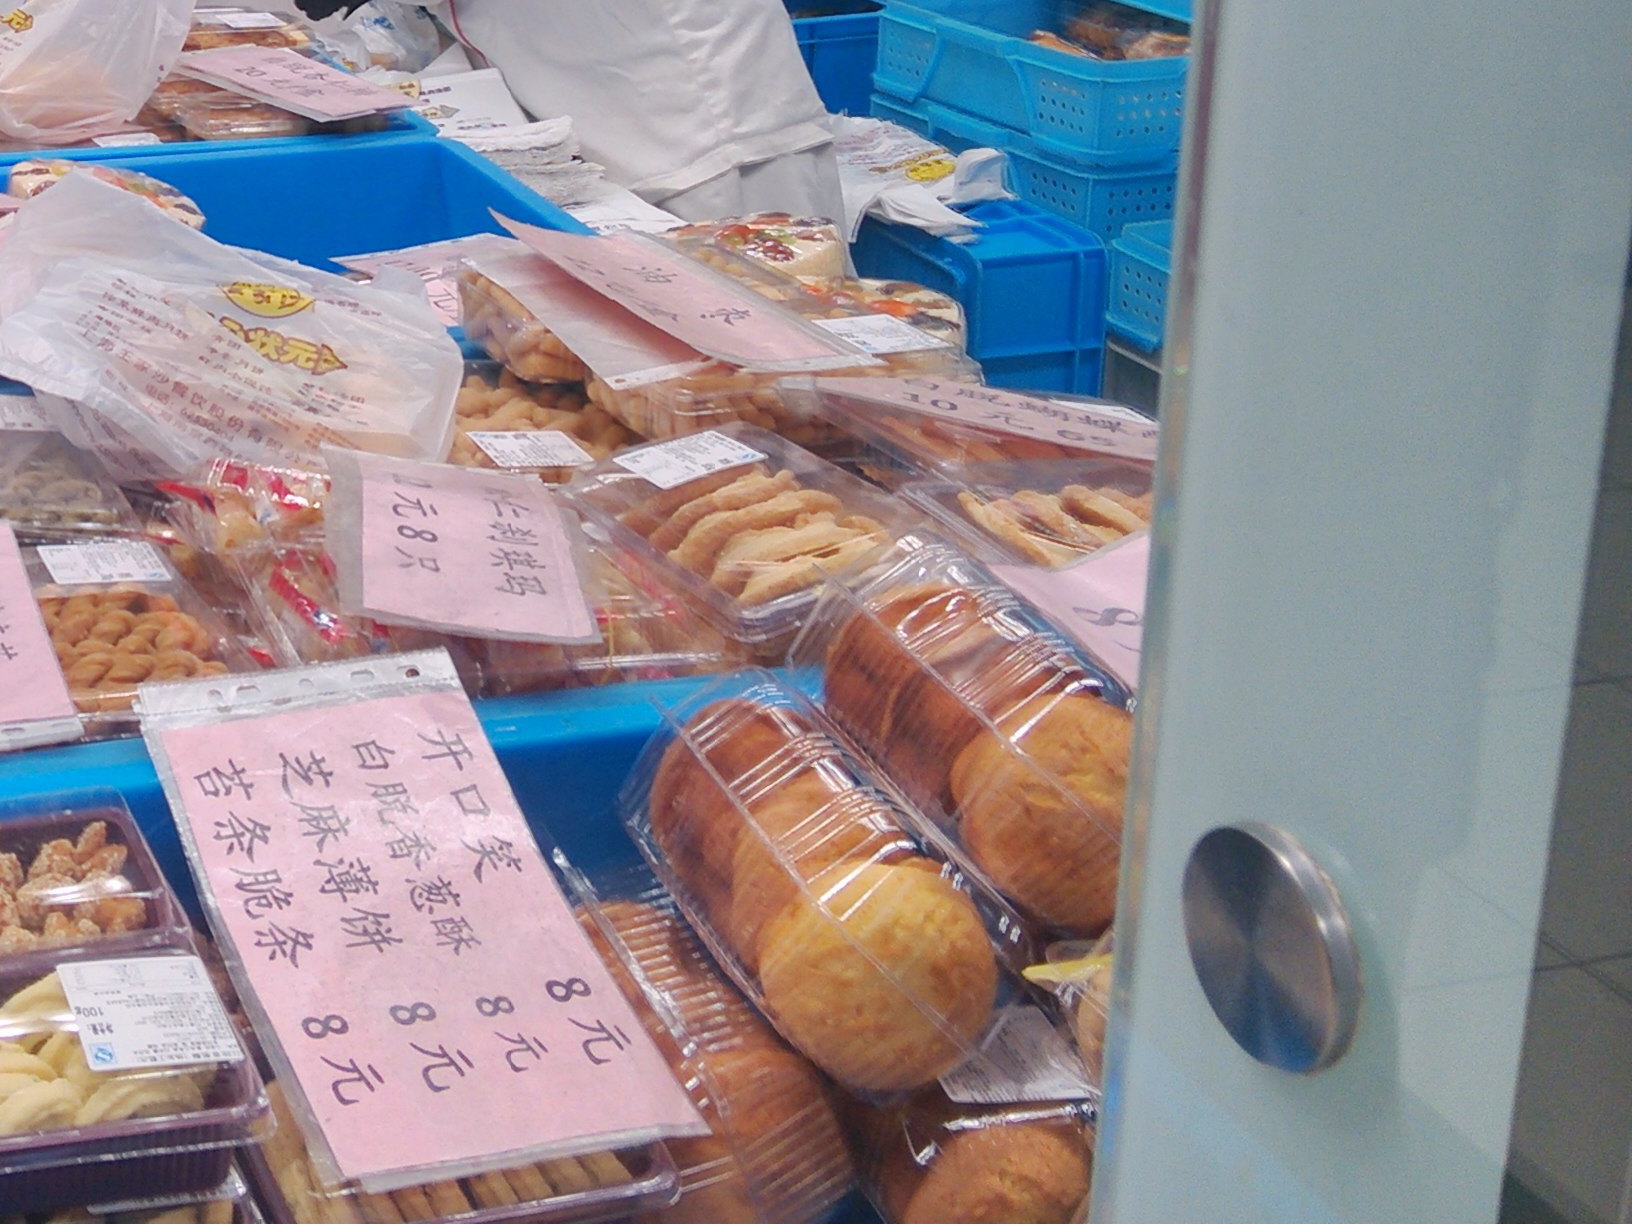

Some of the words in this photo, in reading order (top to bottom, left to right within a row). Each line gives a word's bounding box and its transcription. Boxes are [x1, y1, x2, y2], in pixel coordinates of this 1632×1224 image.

[193, 759, 316, 971] 苔条脆条
[300, 1012, 386, 1107] 8元
[277, 749, 405, 955] 芝麻薄饼
[388, 1001, 476, 1093] 8元
[351, 739, 482, 956] 白脱香葱酥
[474, 993, 550, 1075] 8元
[416, 728, 524, 884] 开口笑
[544, 976, 633, 1067] 8元
